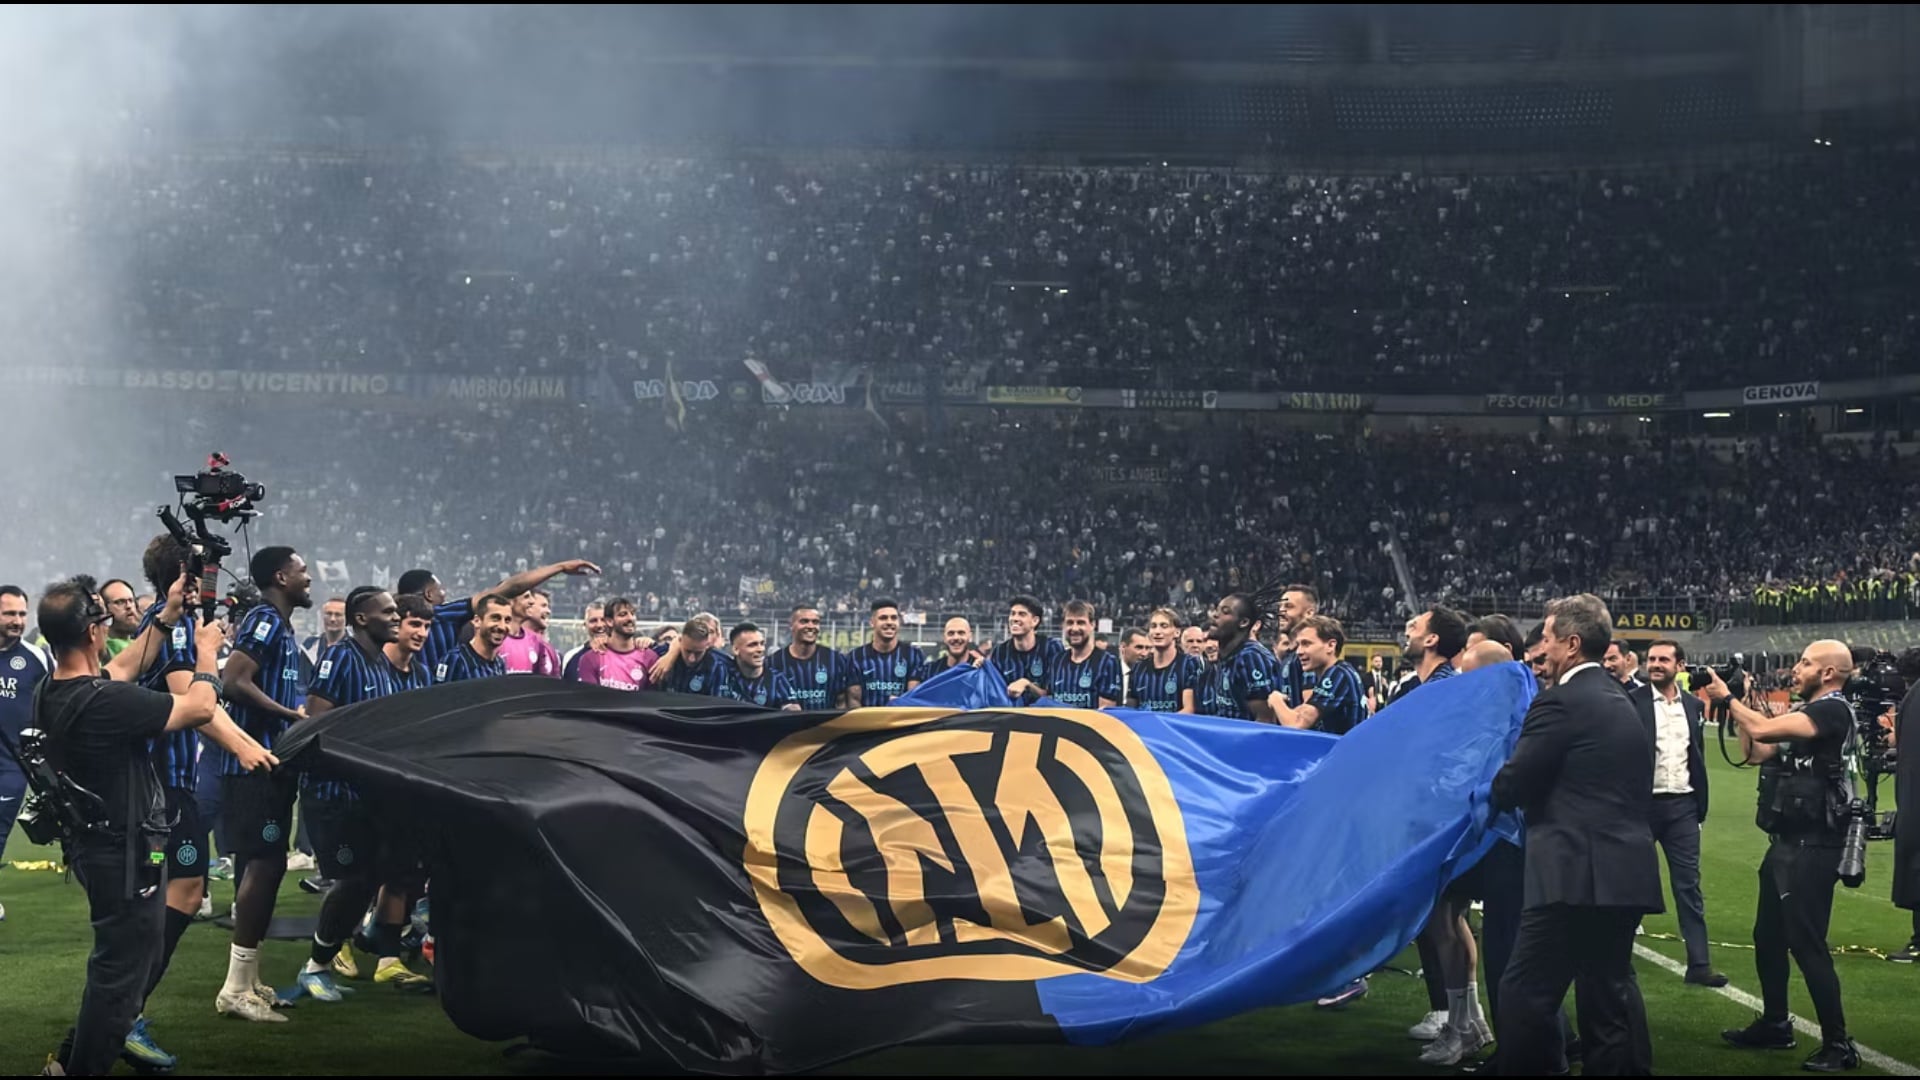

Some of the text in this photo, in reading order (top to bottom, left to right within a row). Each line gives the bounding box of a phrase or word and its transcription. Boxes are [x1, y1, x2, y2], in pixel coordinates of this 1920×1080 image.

[124, 370, 388, 394] BASSO VICENTINO
[447, 377, 566, 399] AMBROSIANA
[1291, 392, 1360, 409] SENAGO
[1607, 394, 1665, 407] MEDE
[1745, 383, 1817, 401] GENOVA
[1616, 613, 1691, 629] ABANO
